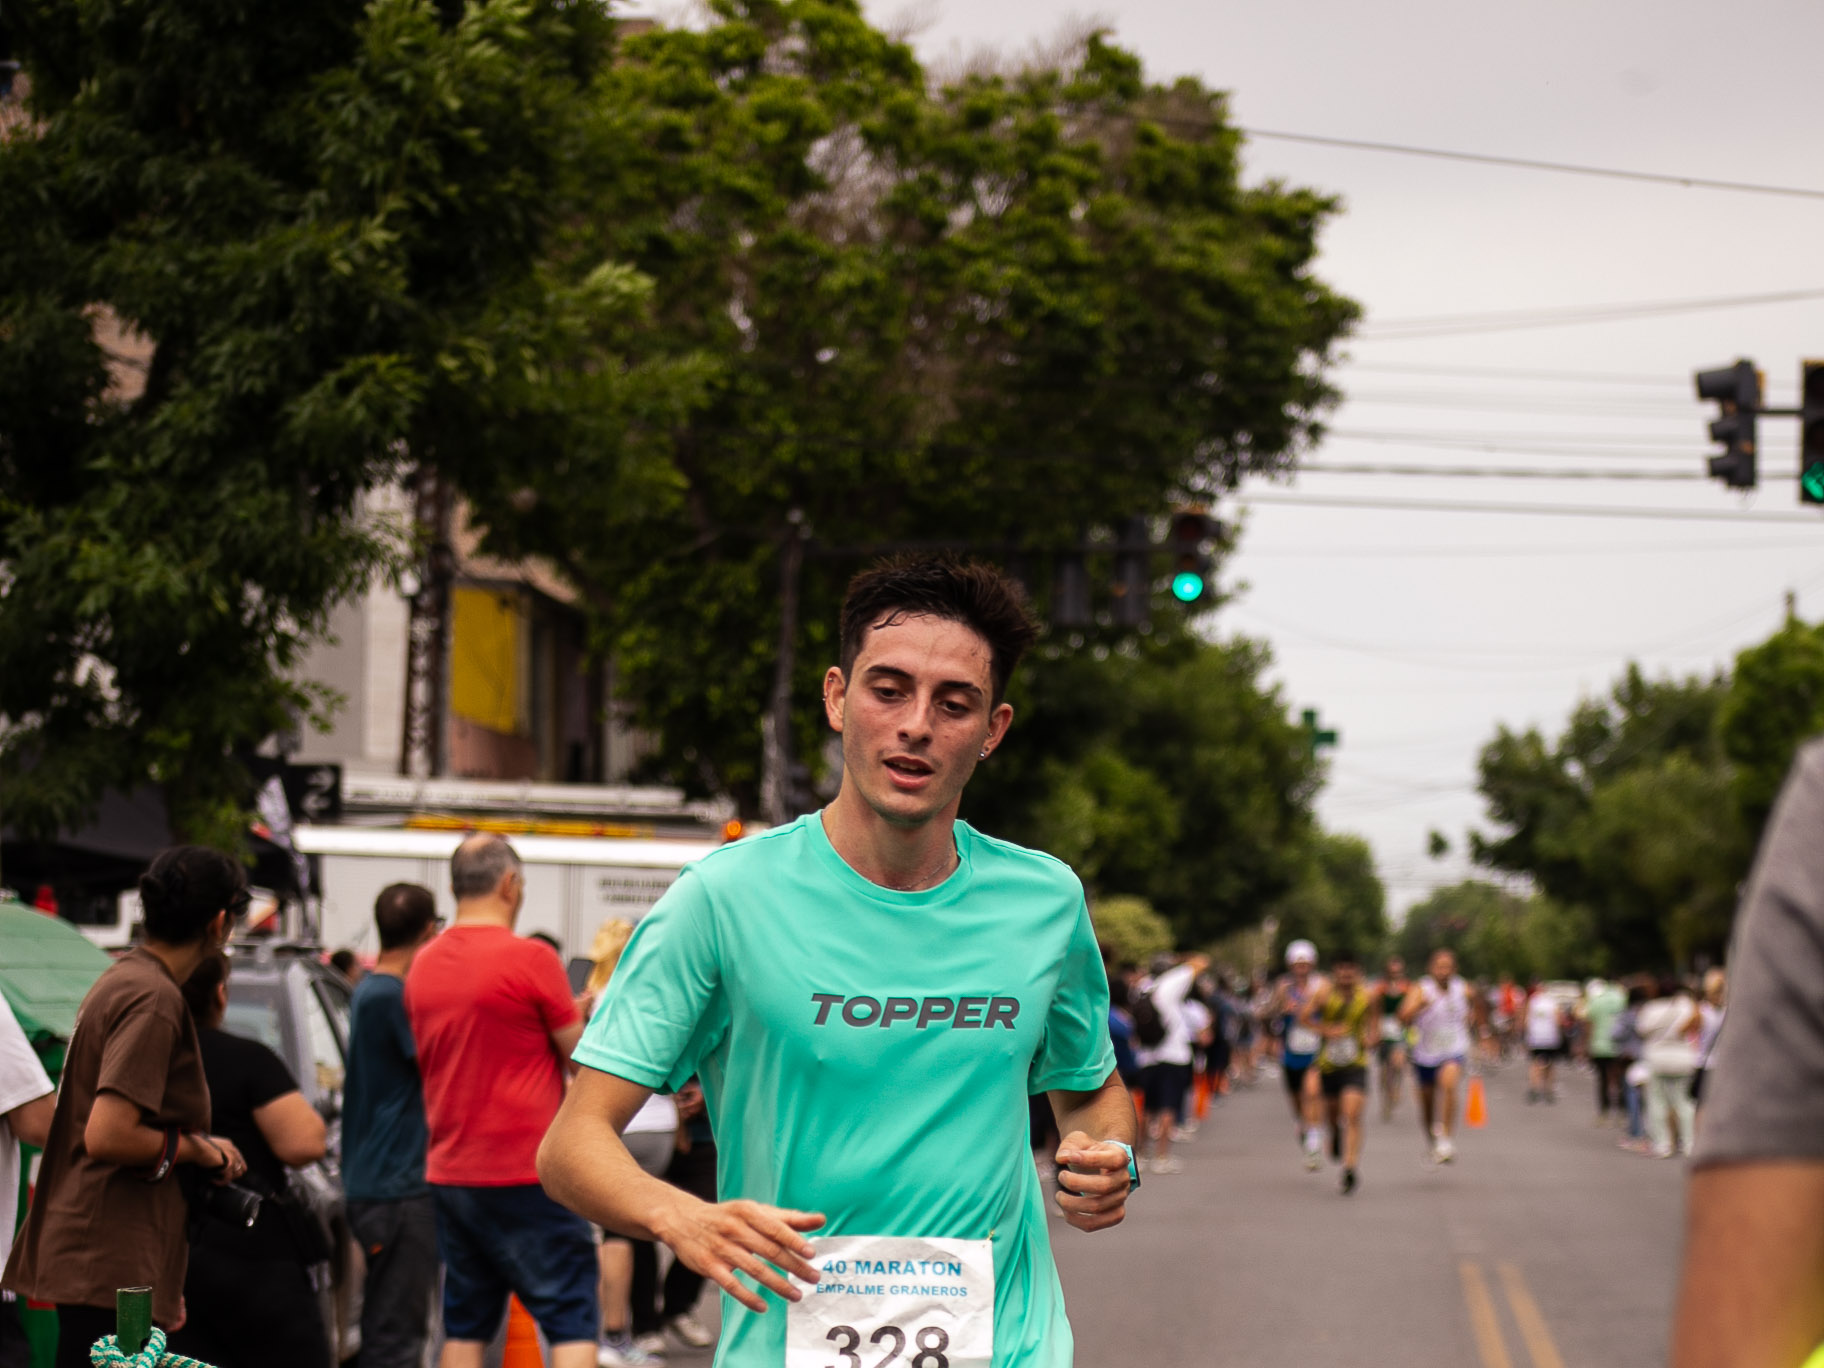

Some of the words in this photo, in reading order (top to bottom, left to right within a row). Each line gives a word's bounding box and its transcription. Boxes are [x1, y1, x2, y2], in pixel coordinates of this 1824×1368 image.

[811, 993, 1020, 1030] TOPPER
[822, 1260, 847, 1275] 40
[855, 1260, 962, 1276] MARATON
[816, 1283, 885, 1296] EMPALME
[889, 1284, 968, 1297] GRANEROS
